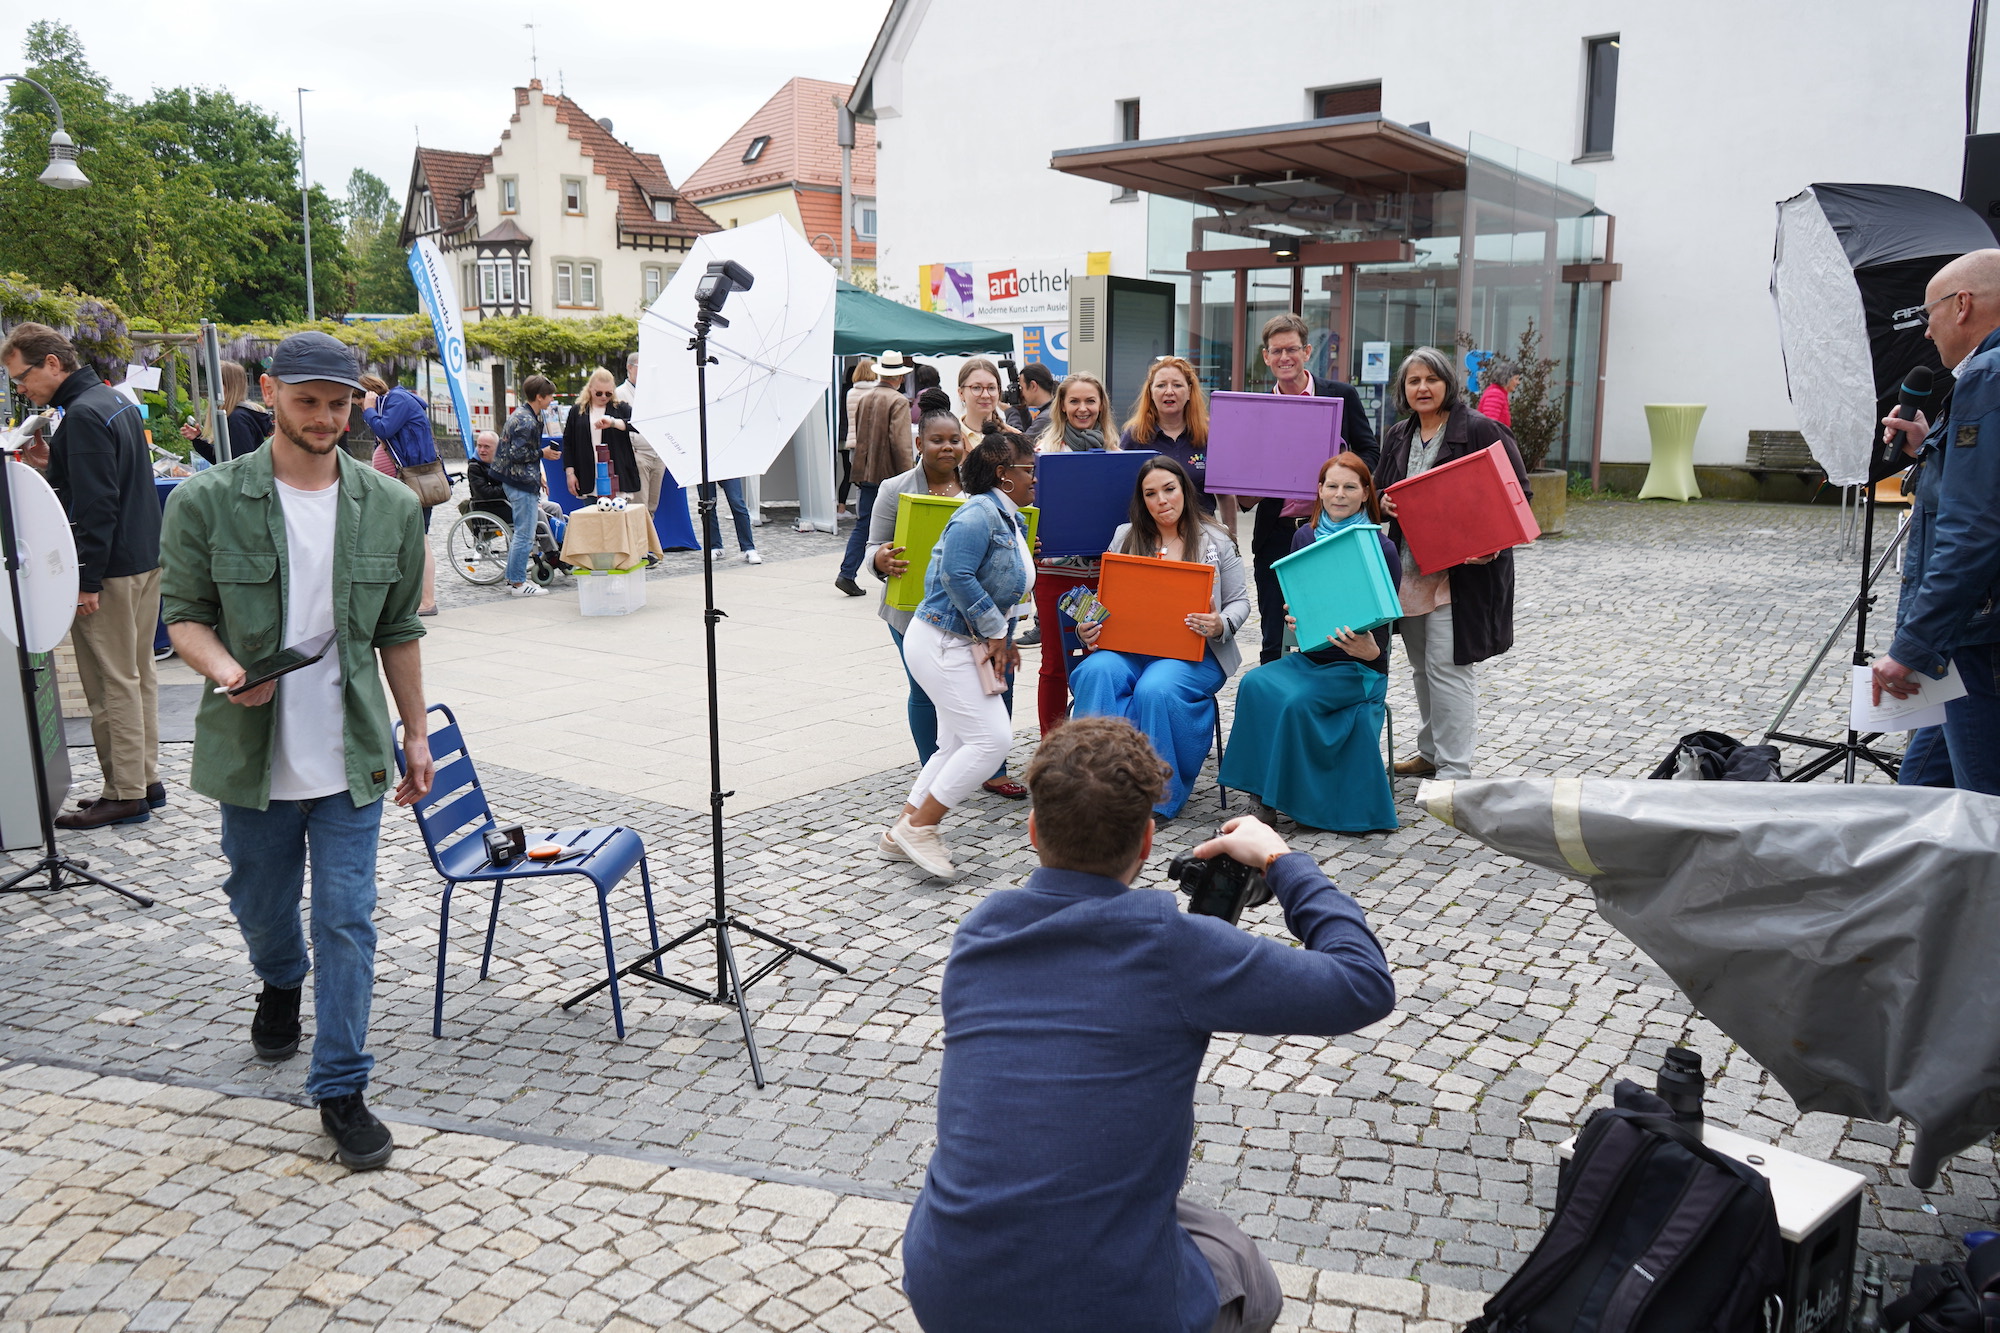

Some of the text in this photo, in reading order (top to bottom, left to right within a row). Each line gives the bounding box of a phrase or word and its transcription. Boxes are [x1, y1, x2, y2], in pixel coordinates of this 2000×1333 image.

[978, 306, 1008, 315] Moderne
[1009, 304, 1028, 313] Kunst
[1030, 303, 1045, 312] zum
